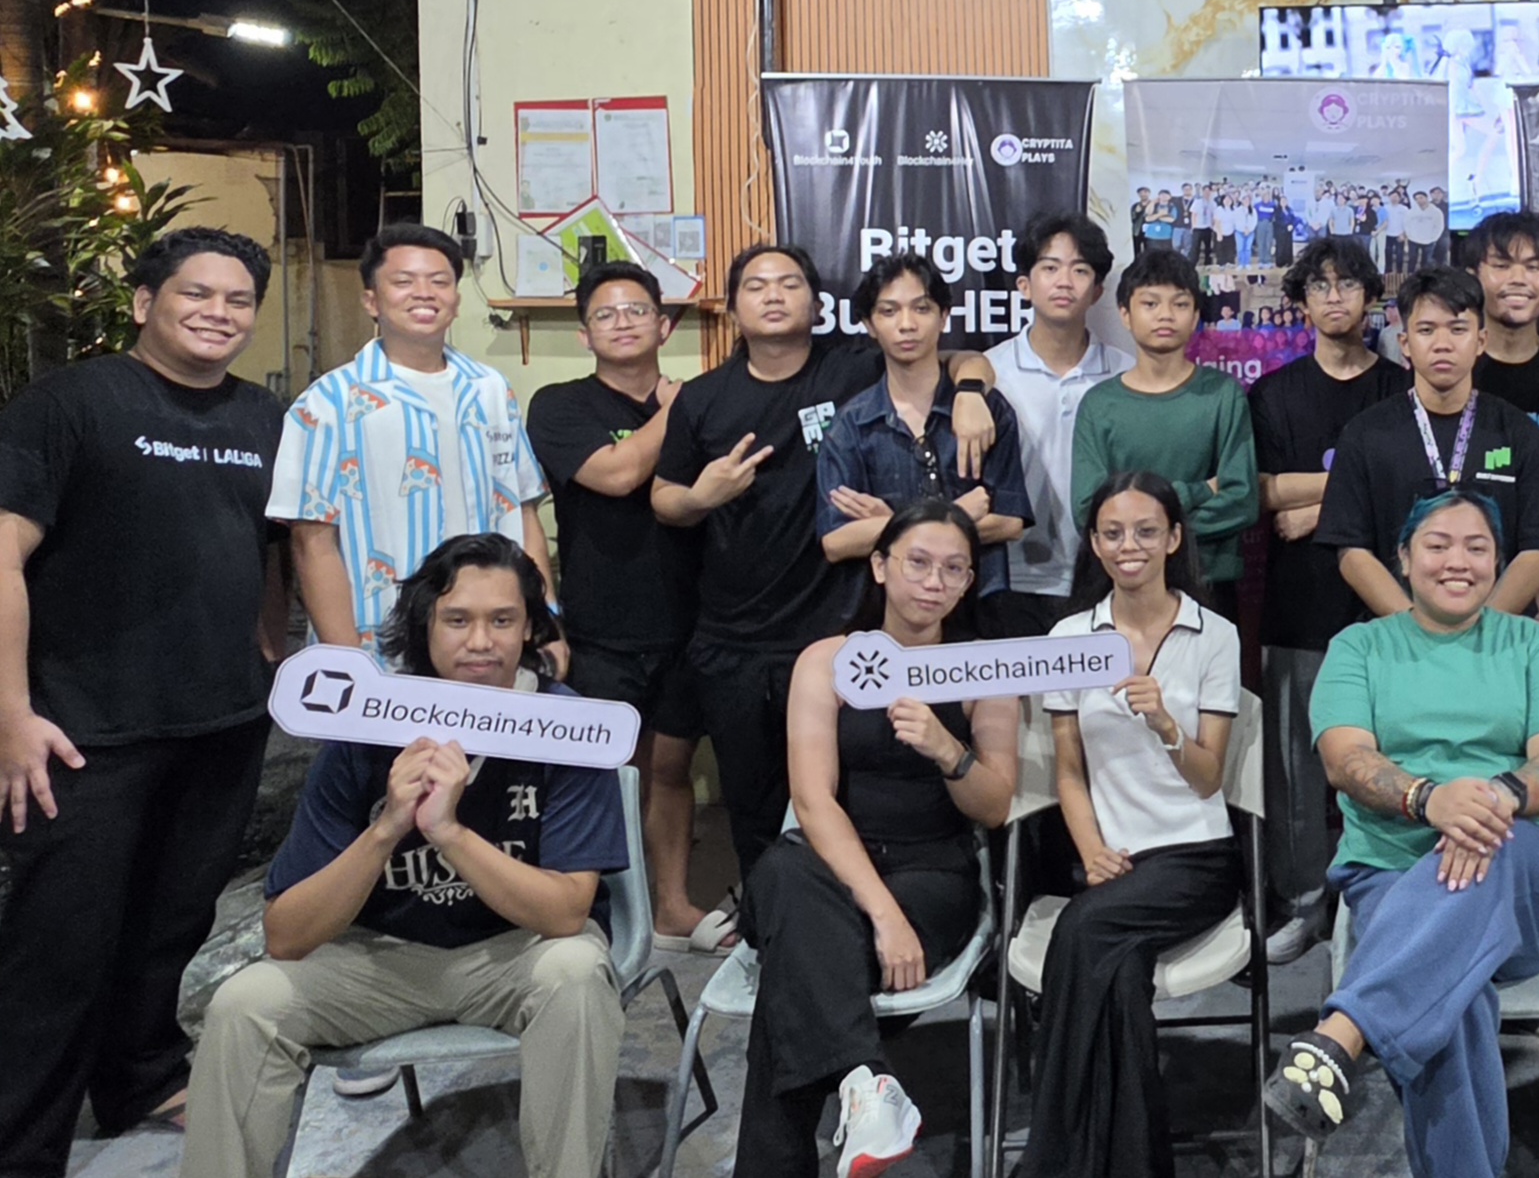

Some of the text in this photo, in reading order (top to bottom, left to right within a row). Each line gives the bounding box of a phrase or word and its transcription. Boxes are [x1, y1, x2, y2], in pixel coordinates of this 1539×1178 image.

[1356, 115, 1408, 129] PLAYS
[1021, 137, 1074, 150] CRYPTITA
[1021, 152, 1056, 164] PLAYS
[860, 226, 1018, 283] Bitget
[152, 441, 201, 462] Bitget
[907, 652, 1114, 688] Blockchain4Her
[361, 697, 613, 745] Blockchain4Youth
